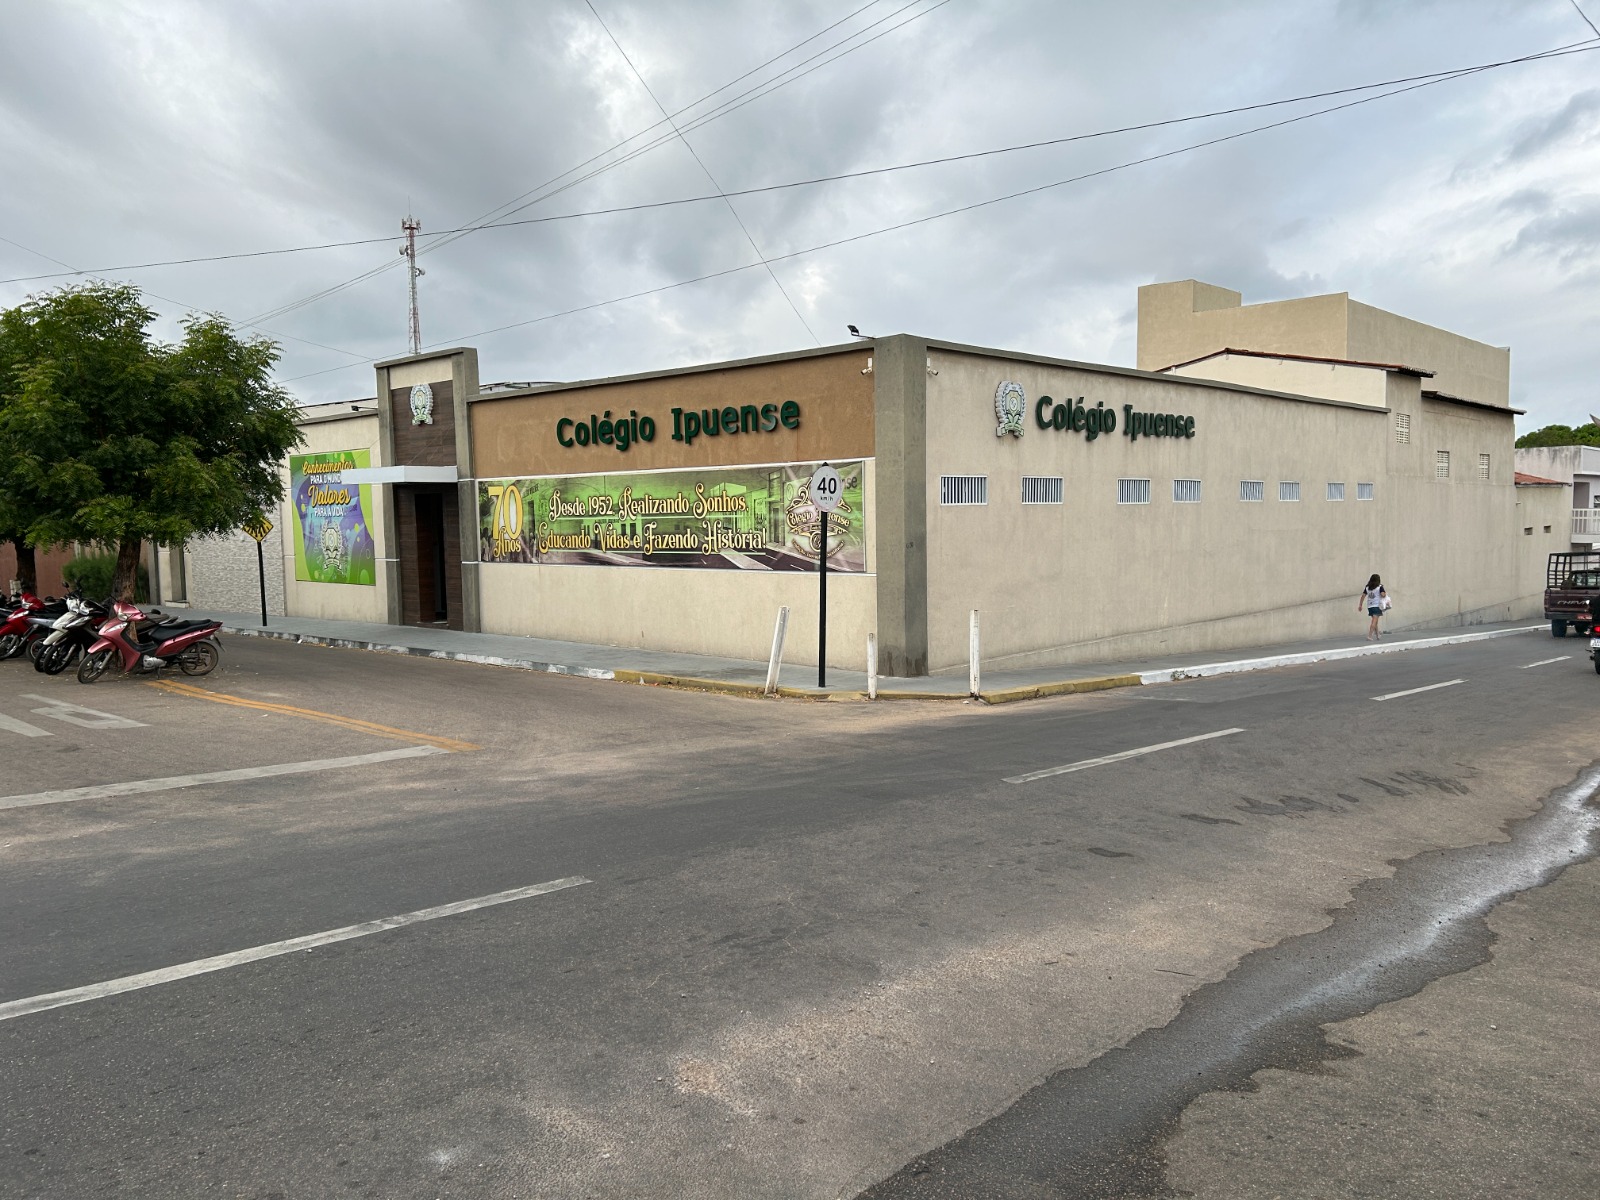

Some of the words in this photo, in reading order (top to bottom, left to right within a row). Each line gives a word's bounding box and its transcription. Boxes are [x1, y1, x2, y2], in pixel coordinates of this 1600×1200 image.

[556, 410, 655, 450] Colégio
[671, 400, 799, 445] Ipuense
[1036, 395, 1116, 441] Colégio
[1124, 403, 1195, 441] Ipuense
[308, 485, 351, 508] Valores
[817, 477, 837, 494] 40
[488, 486, 524, 540] 70
[549, 489, 586, 522] Desde
[618, 486, 689, 522] Realizando
[493, 527, 521, 558] Anos
[537, 521, 591, 554] Educando
[593, 522, 630, 552] Vidas
[633, 535, 641, 548] e
[643, 520, 699, 555] Fazendo
[701, 519, 767, 556] História!
